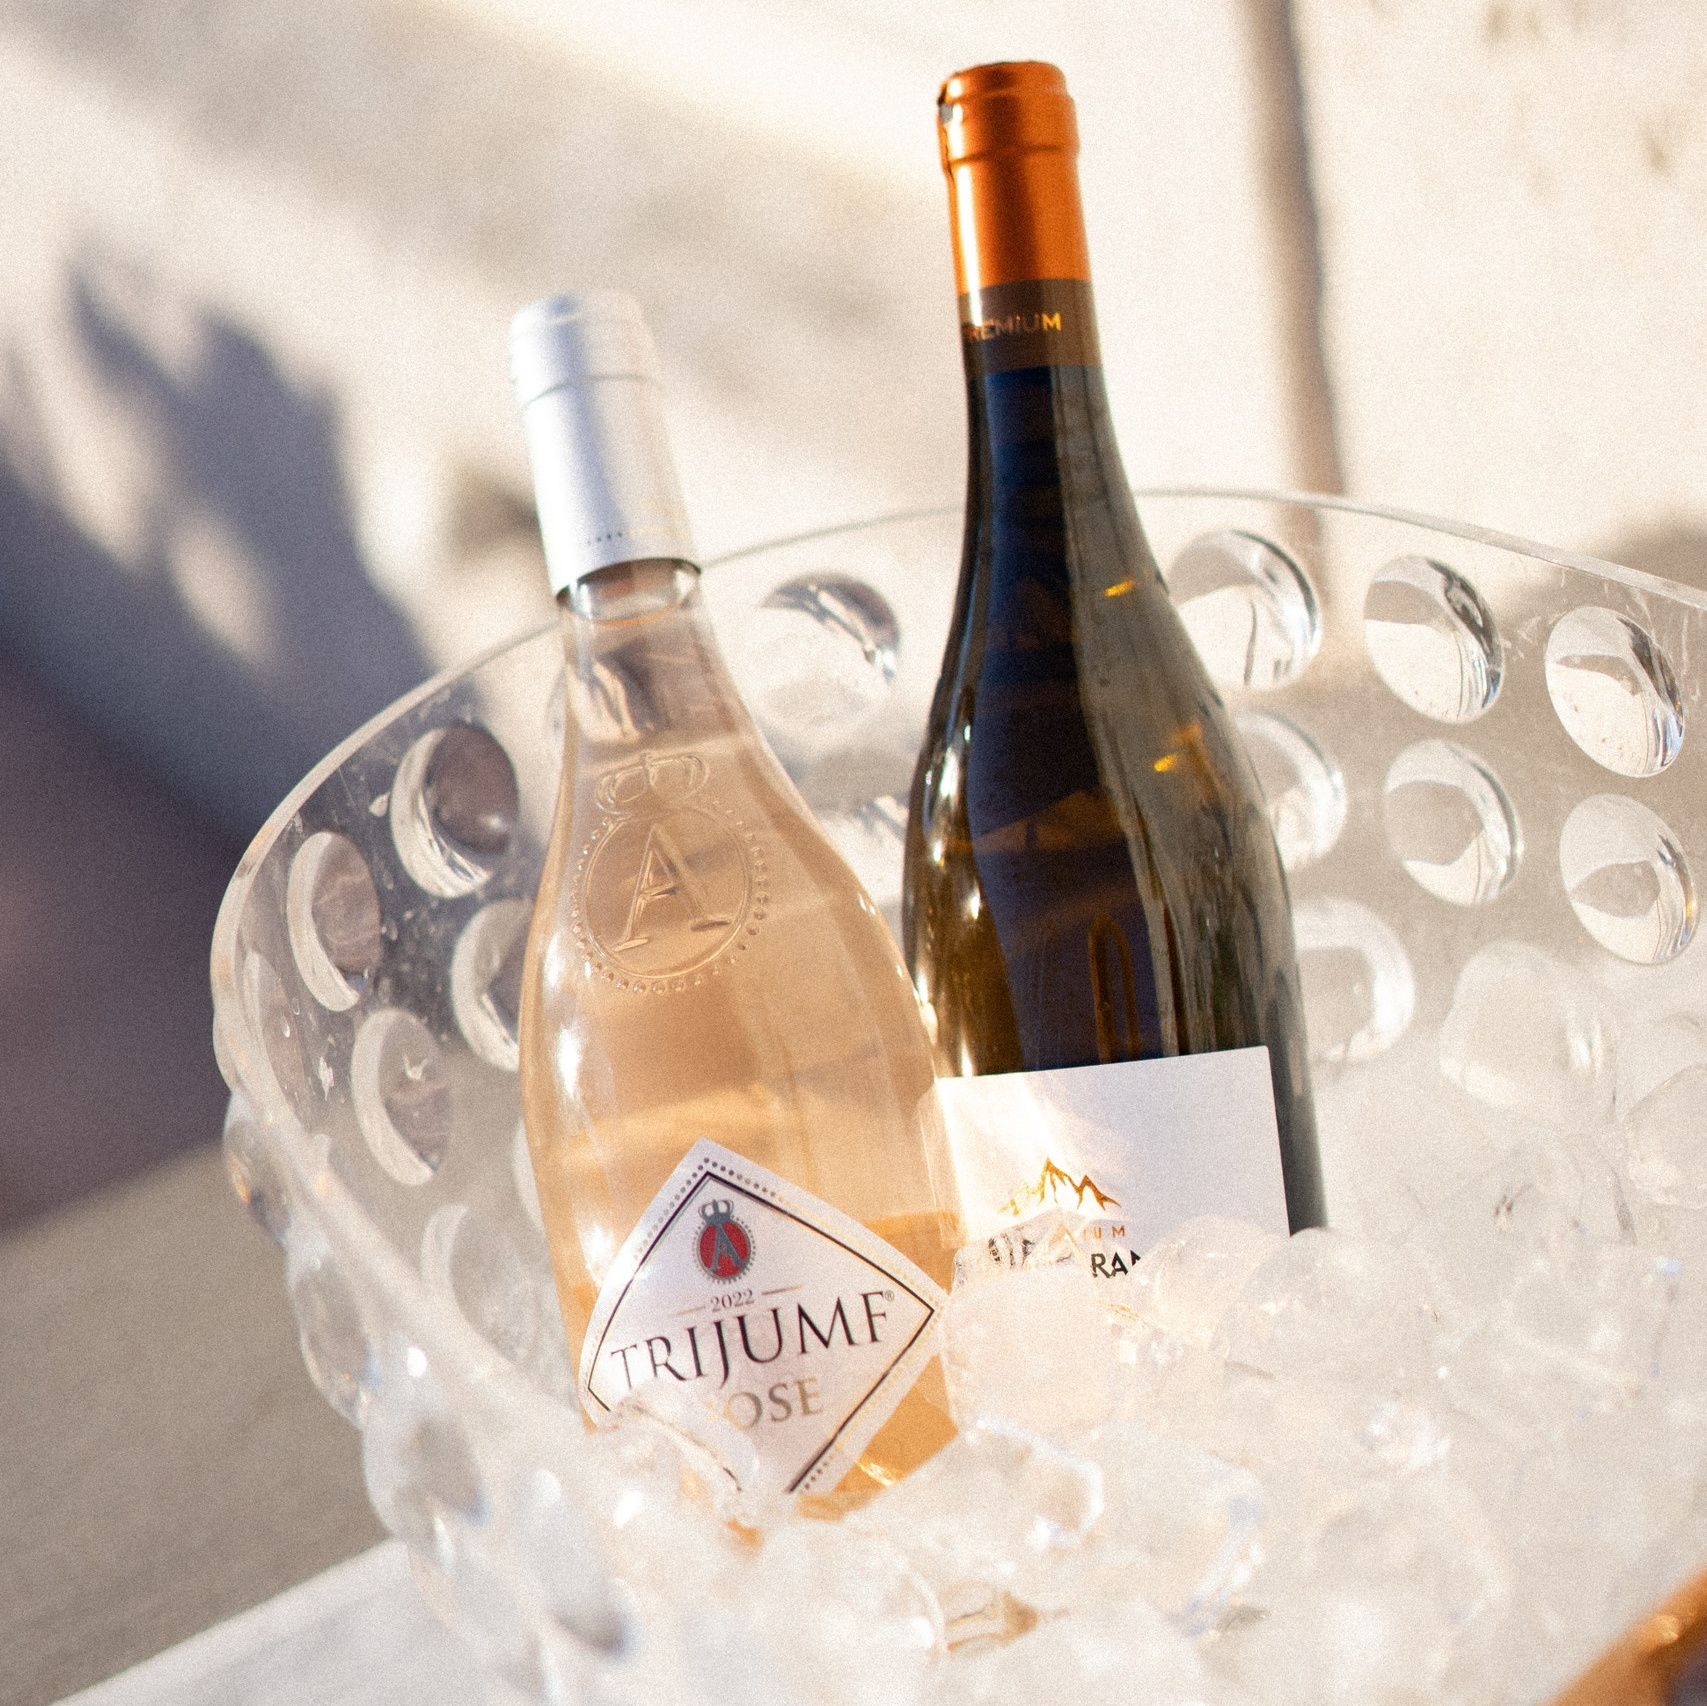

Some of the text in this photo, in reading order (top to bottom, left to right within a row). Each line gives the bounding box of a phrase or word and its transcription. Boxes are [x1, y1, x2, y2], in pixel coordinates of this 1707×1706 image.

[612, 824, 731, 952] A
[709, 1222, 747, 1271] A
[710, 1288, 755, 1312] 2022
[704, 1376, 824, 1431] OSE
